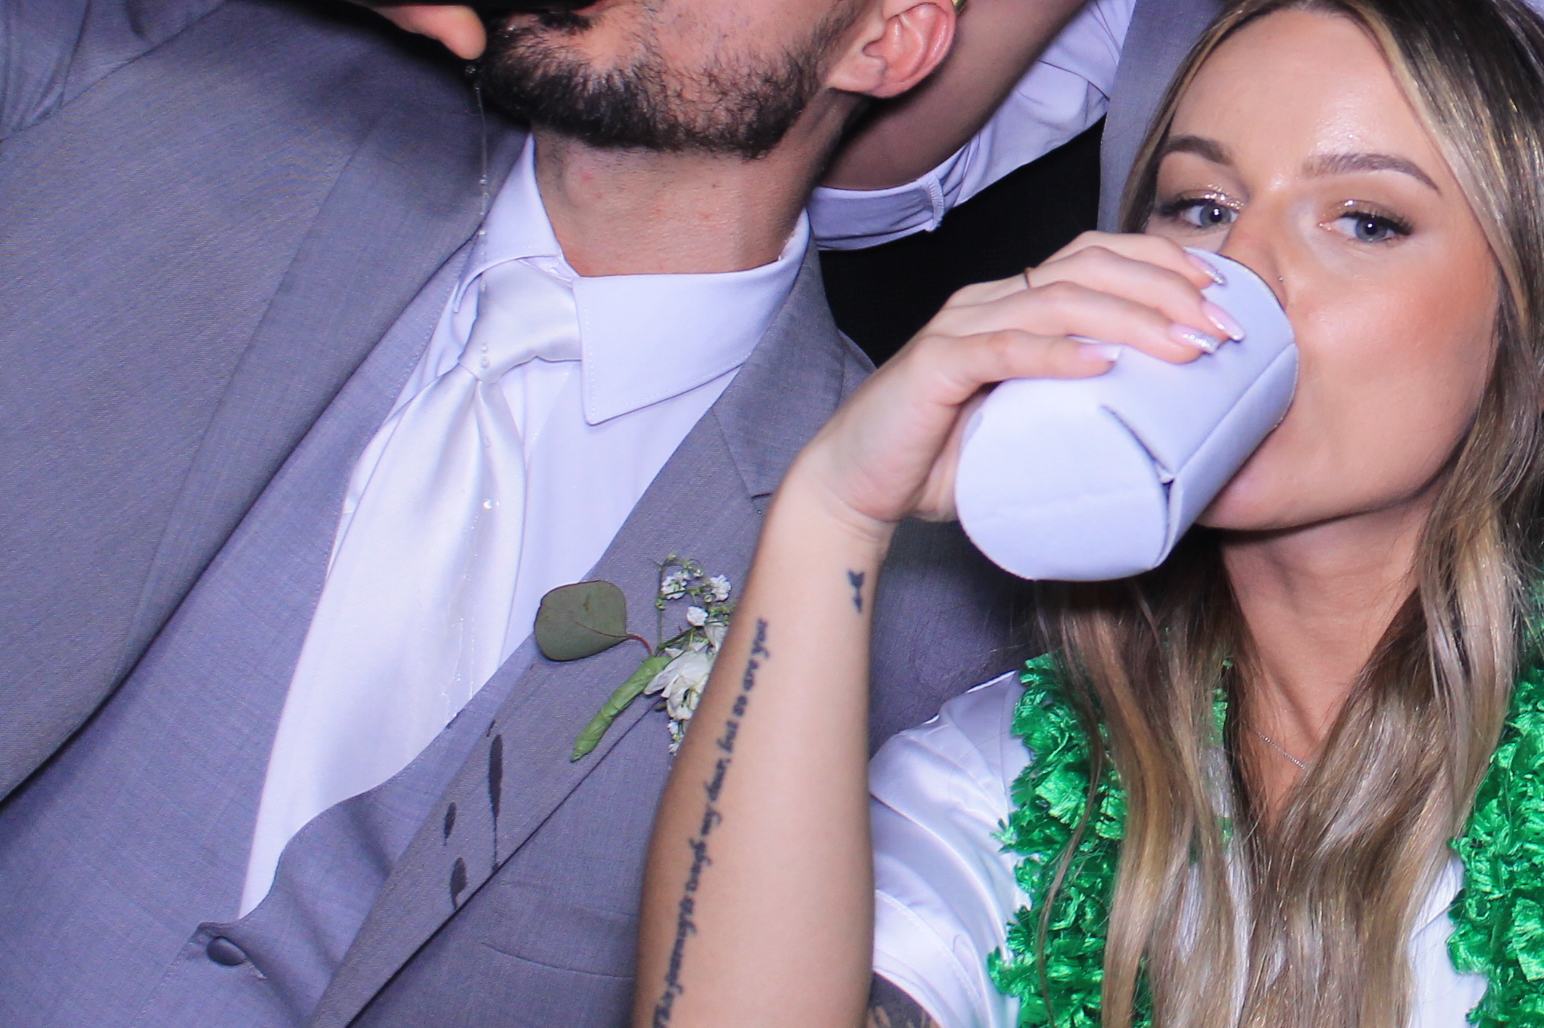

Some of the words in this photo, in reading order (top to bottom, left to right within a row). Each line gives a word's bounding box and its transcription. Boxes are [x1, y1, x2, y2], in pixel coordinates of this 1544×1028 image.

[751, 619, 769, 658] you
[743, 660, 758, 690] are
[733, 695, 747, 717] so
[717, 720, 738, 752] but
[704, 757, 731, 801] dear,
[700, 803, 722, 837] my
[685, 837, 711, 893] tough
[664, 912, 696, 995] journey
